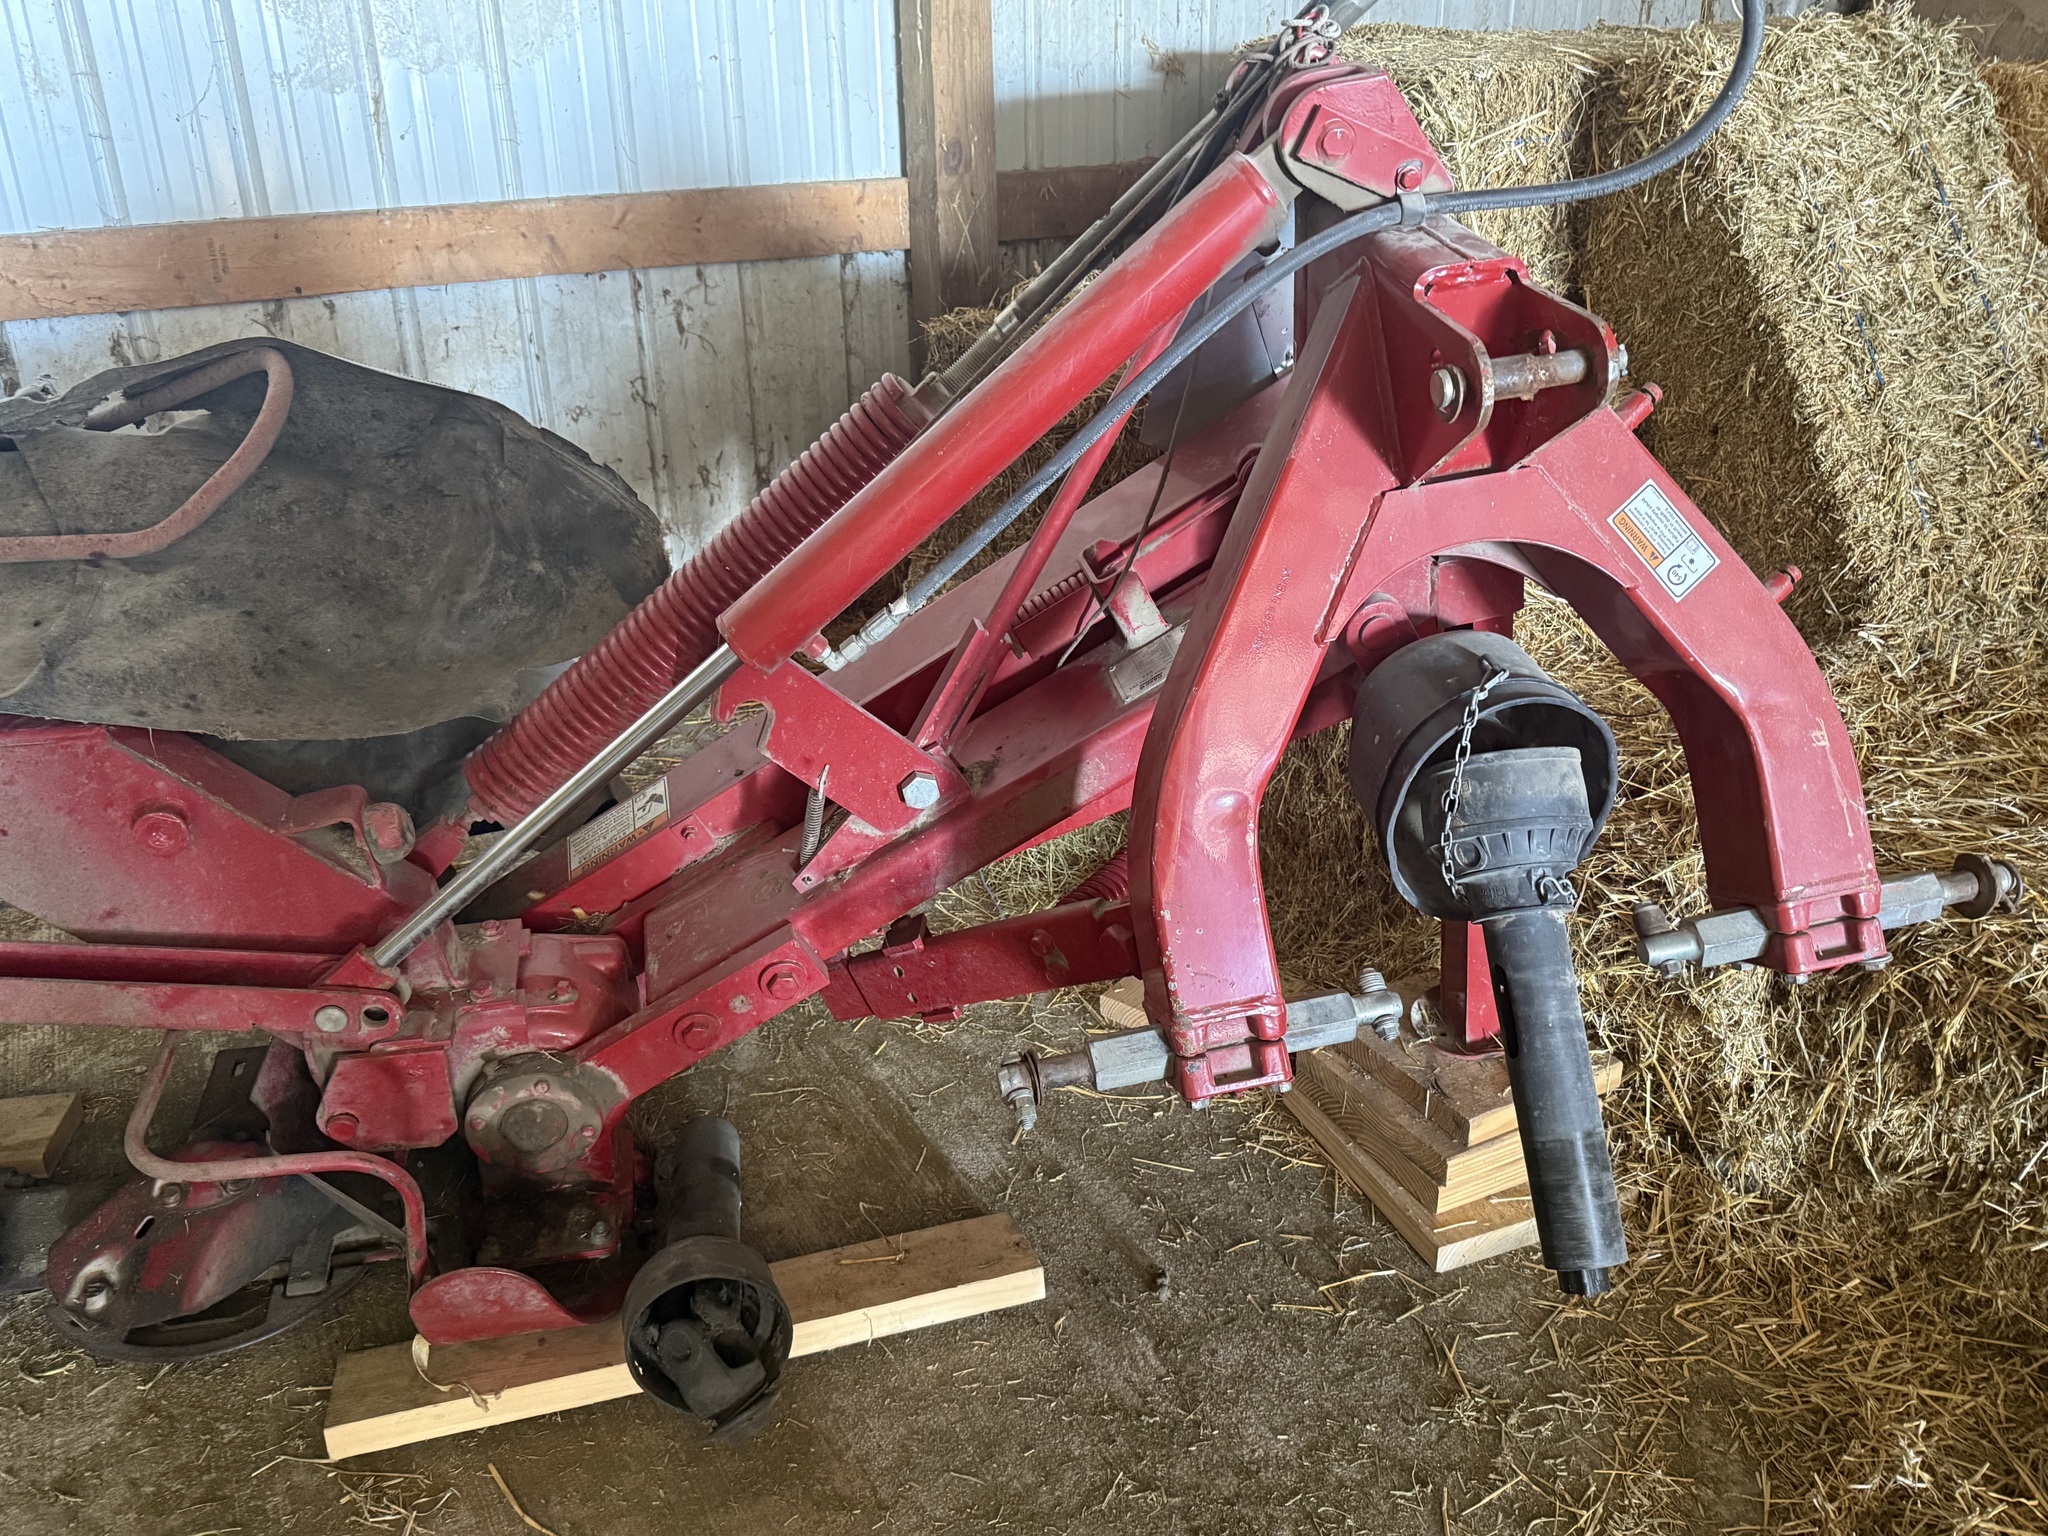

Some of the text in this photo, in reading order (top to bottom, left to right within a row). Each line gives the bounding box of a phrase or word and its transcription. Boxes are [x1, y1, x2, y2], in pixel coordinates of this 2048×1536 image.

[1640, 497, 1652, 510] could
[1627, 507, 1645, 527] component
[1633, 506, 1643, 517] place
[1650, 508, 1665, 524] comply
[1659, 510, 1670, 523] death
[1648, 524, 1658, 535] MUST
[1659, 529, 1667, 538] PTO
[1672, 526, 1684, 539] result
[1674, 519, 1687, 535] serious
[1617, 516, 1649, 552] WARNING
[1648, 533, 1656, 542] PTO
[1666, 527, 1680, 543] Failure
[1656, 534, 1671, 550] shielding
[1665, 537, 1675, 547] when
[1670, 568, 1683, 581] 540
[582, 834, 636, 872] WARNING
